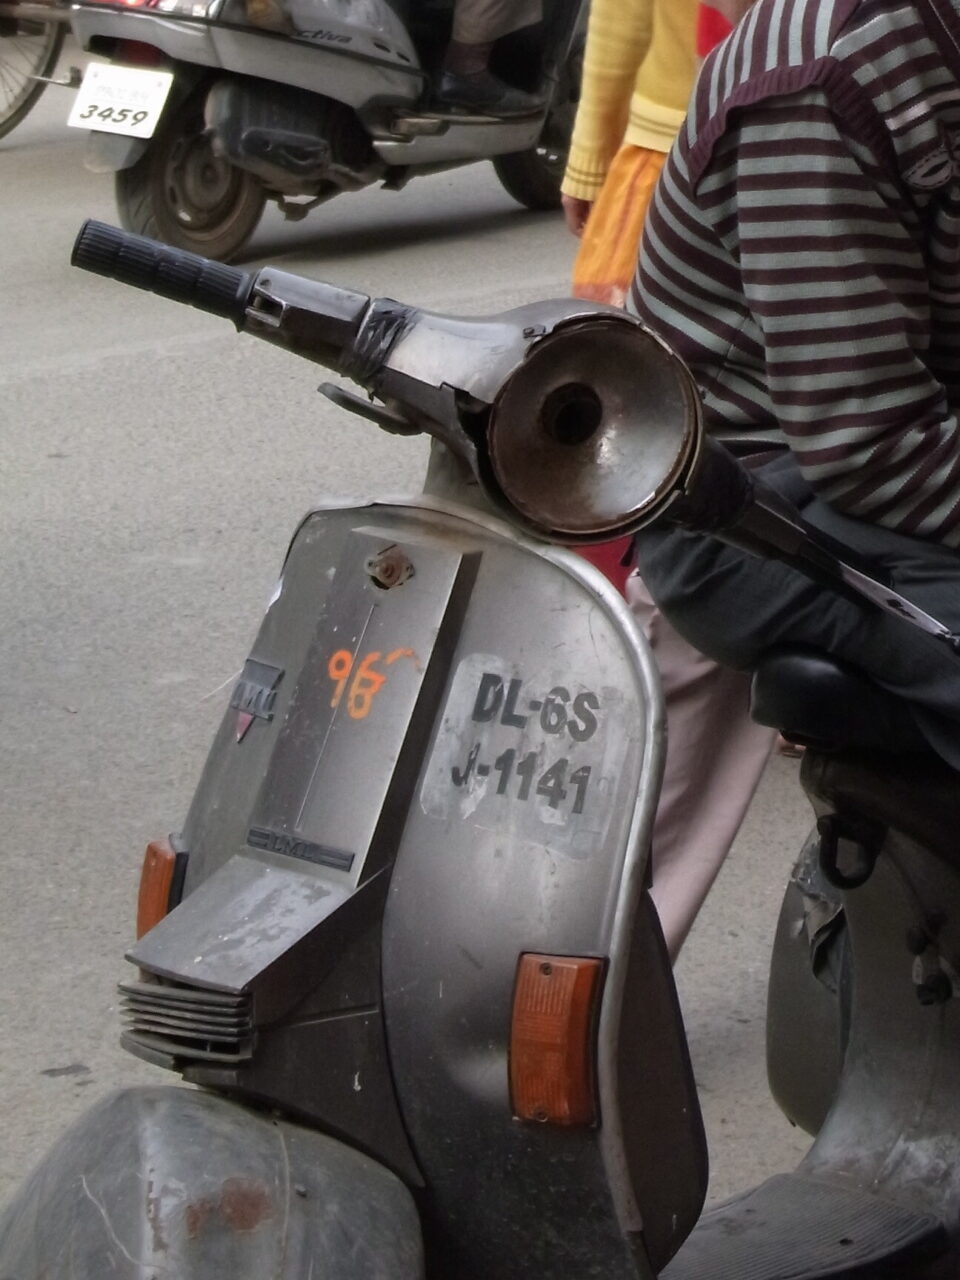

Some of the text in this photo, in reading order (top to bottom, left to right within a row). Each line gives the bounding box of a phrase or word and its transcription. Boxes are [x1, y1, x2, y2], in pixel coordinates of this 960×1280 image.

[80, 104, 149, 127] 3459
[472, 673, 600, 742] DL-6S
[451, 743, 593, 815] J-1141
